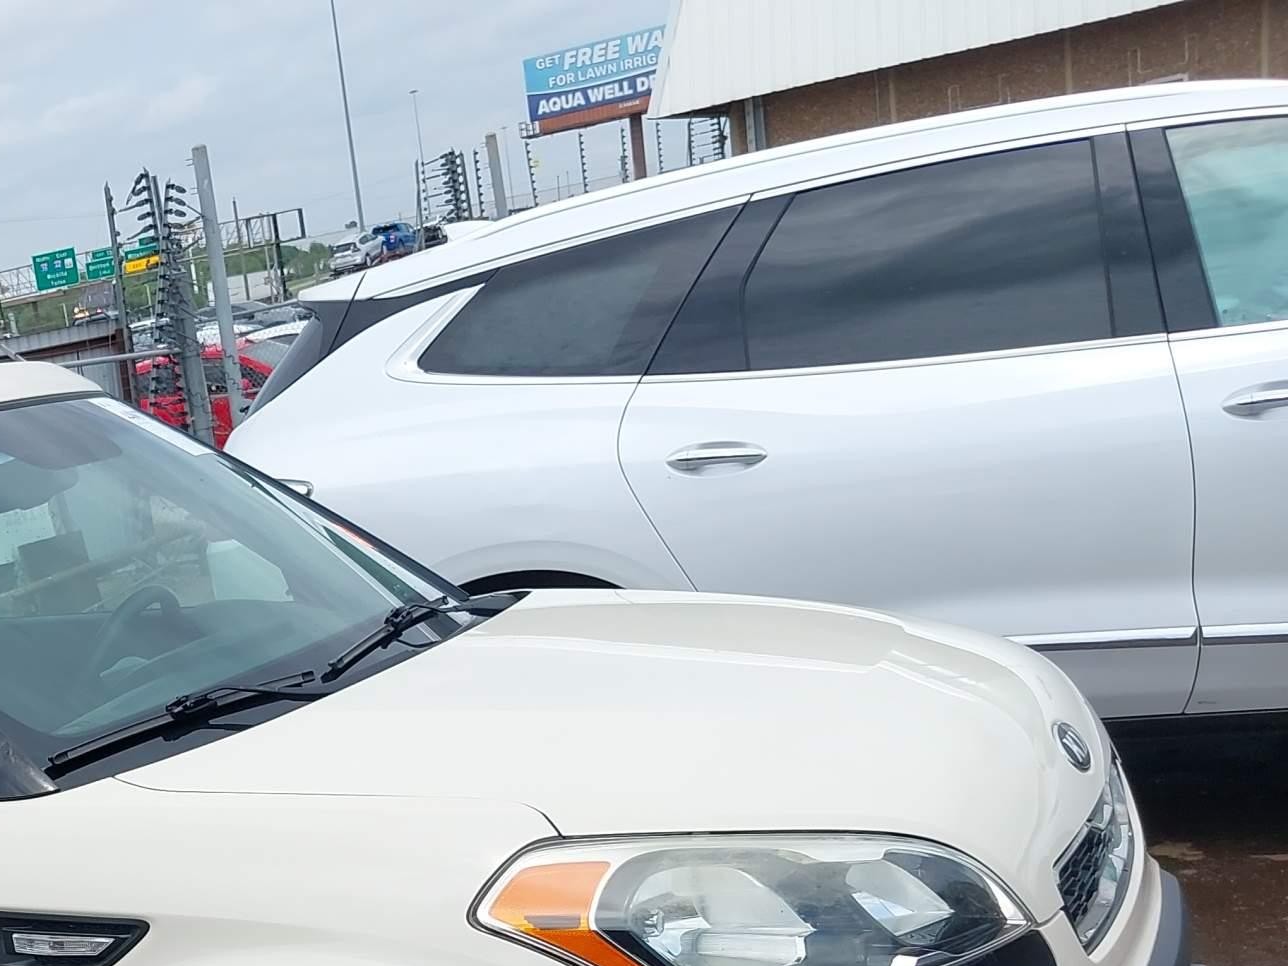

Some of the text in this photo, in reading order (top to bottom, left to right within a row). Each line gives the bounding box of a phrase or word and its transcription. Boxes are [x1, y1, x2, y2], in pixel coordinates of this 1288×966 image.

[535, 30, 664, 70] GET FREE WA
[548, 53, 657, 88] FOR LAWN IRRIG
[537, 91, 586, 115] AQUA
[587, 80, 634, 103] WELL
